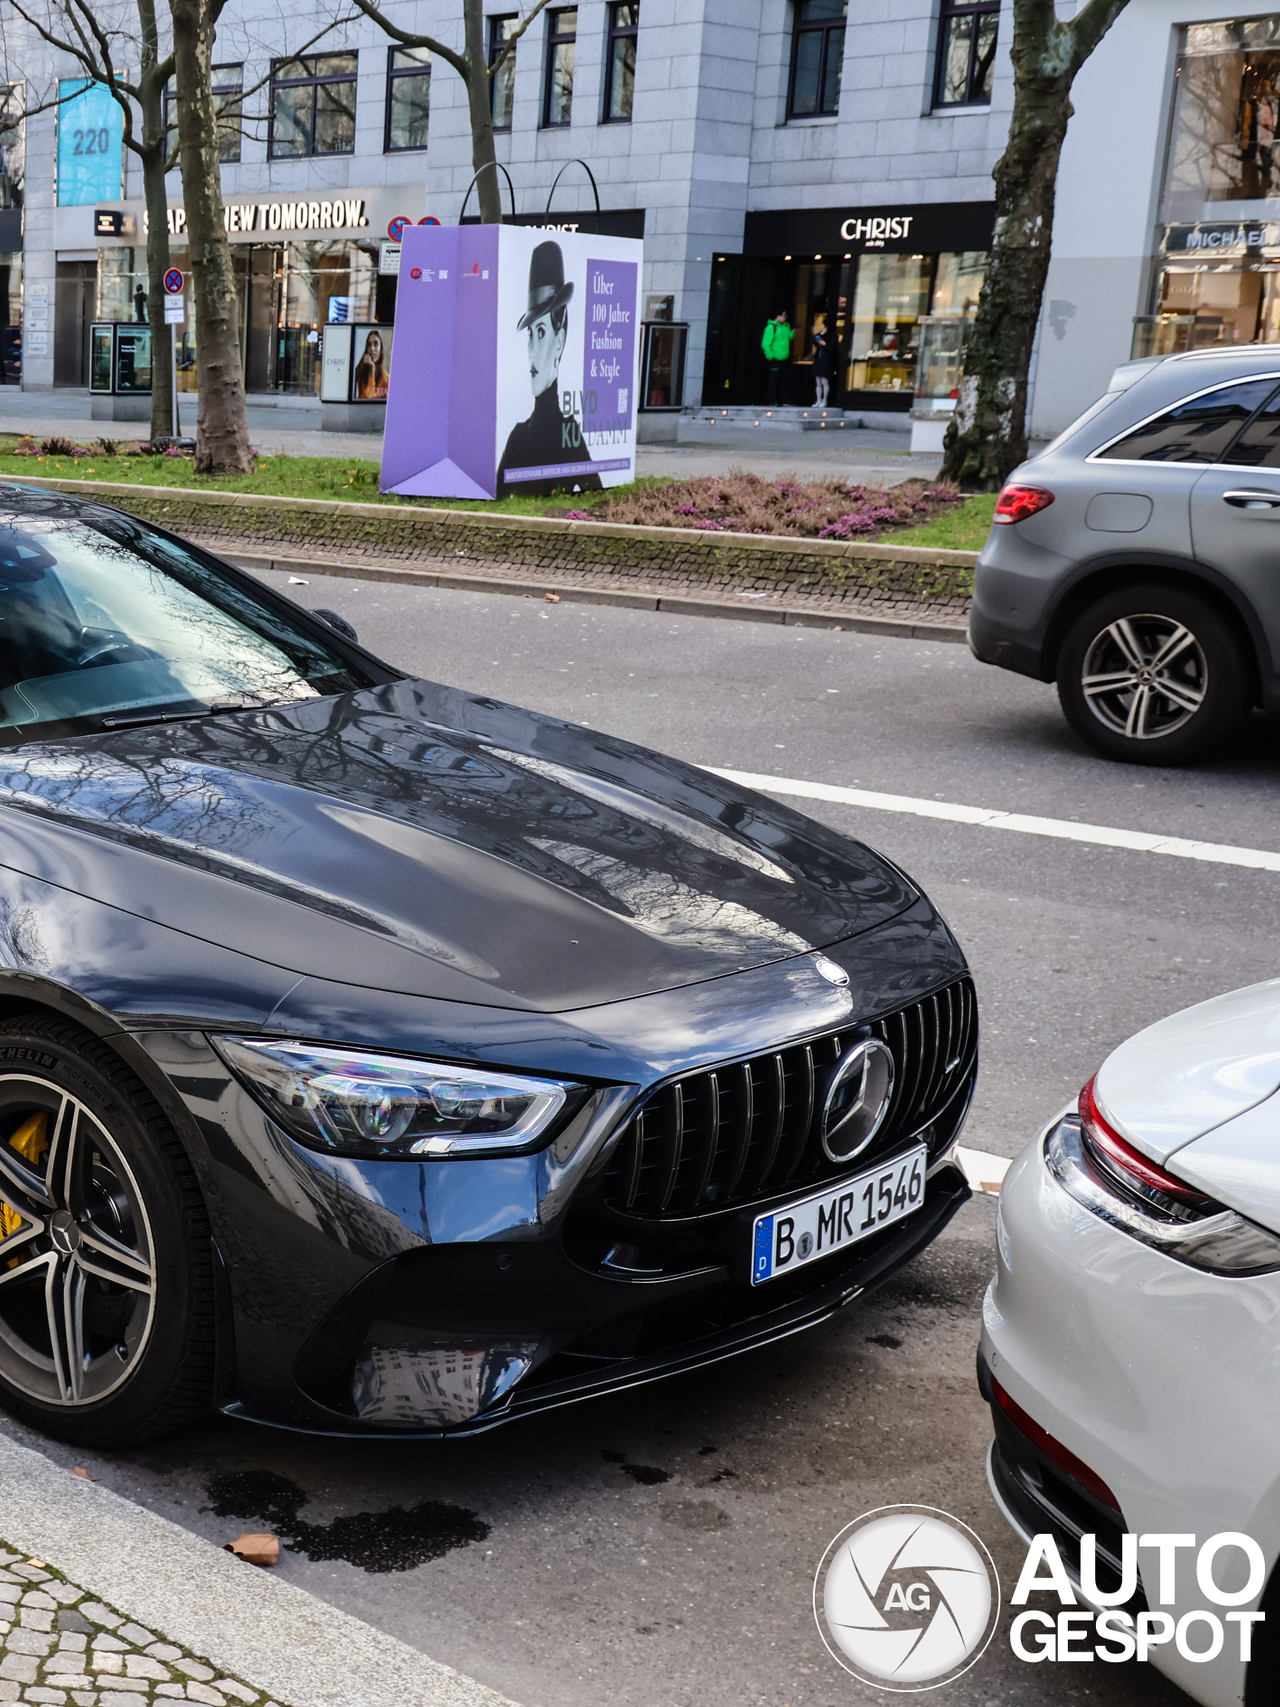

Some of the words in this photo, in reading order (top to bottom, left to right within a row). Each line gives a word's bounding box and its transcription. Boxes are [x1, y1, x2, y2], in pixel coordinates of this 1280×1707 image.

[72, 127, 110, 156] 220
[840, 216, 914, 241] CHRIST
[1186, 230, 1268, 248] MICHAEL
[593, 271, 615, 295] Über
[592, 303, 606, 323] 100
[607, 303, 630, 328] Jahre
[591, 331, 623, 350] Fashion
[590, 358, 598, 378] &
[599, 357, 621, 384] Style
[562, 389, 598, 416] BLVD
[61, 1064, 82, 1081] PILOT
[82, 1078, 102, 1099] ALPIN
[775, 1216, 795, 1268] B
[817, 1191, 854, 1251] MR
[860, 1157, 922, 1231] 1546
[758, 1256, 767, 1271] D
